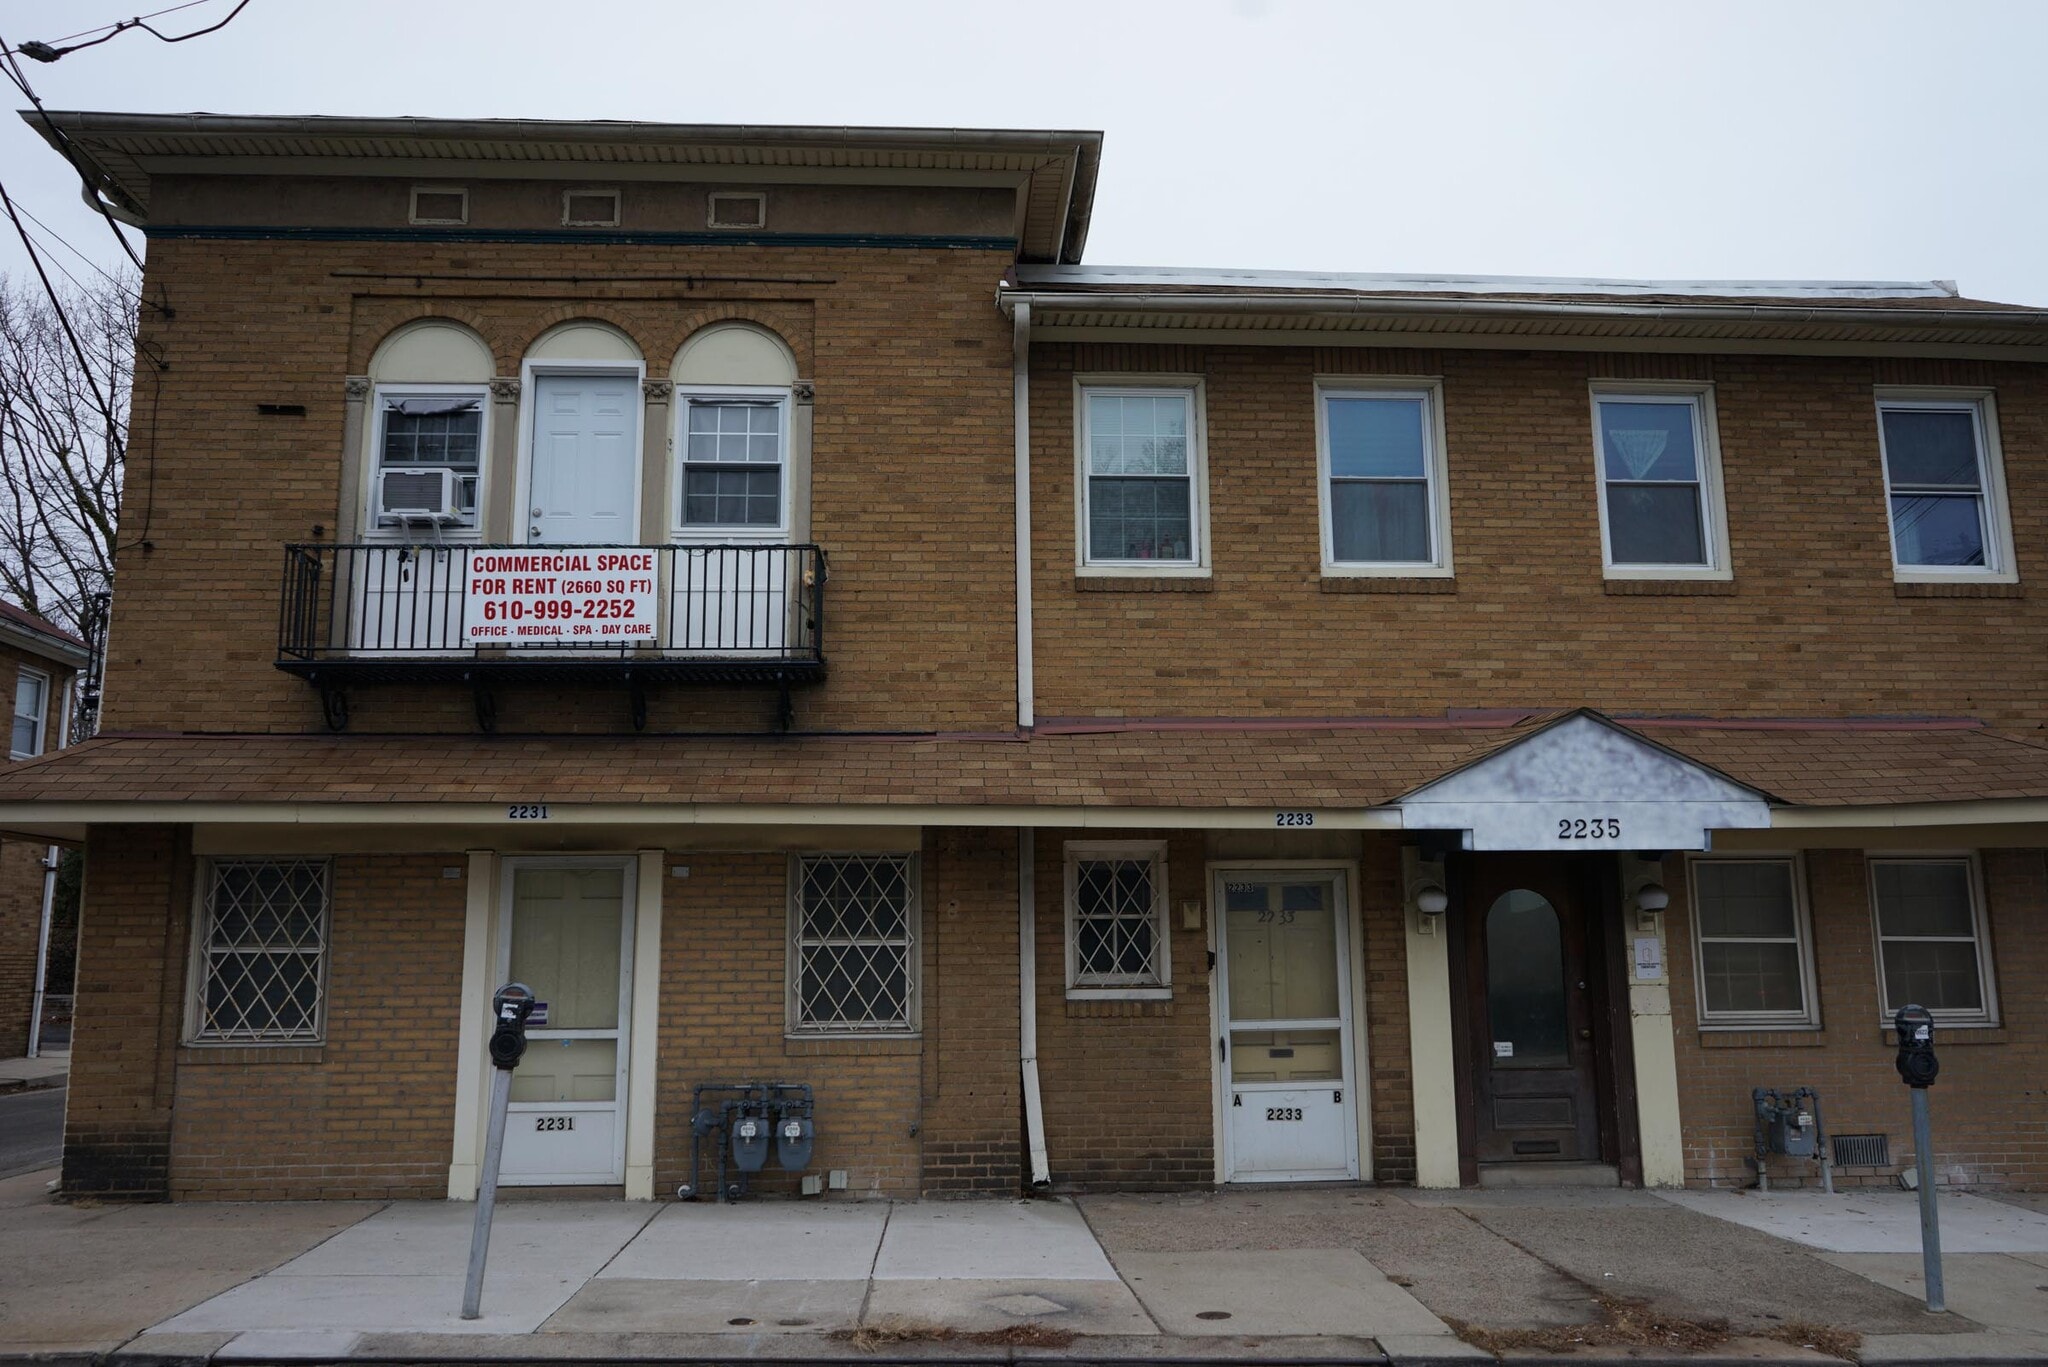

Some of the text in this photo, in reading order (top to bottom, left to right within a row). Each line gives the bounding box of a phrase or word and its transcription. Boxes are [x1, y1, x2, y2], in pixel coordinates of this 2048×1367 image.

[473, 554, 652, 573] COMMERCIAL SPACE
[472, 578, 652, 595] FOR RENT (2660 SQ FT)
[484, 599, 635, 620] 610-999-2252
[471, 624, 651, 637] OFFICE MEDICAL SPA DAY CARE
[509, 805, 548, 819] 2231
[1276, 813, 1314, 826] 2233
[1558, 818, 1621, 839] 2235
[1228, 883, 1254, 893] 2233
[1233, 1094, 1242, 1107] A
[1333, 1090, 1342, 1104] B
[1267, 1108, 1303, 1121] 2233
[537, 1117, 574, 1131] 2231
